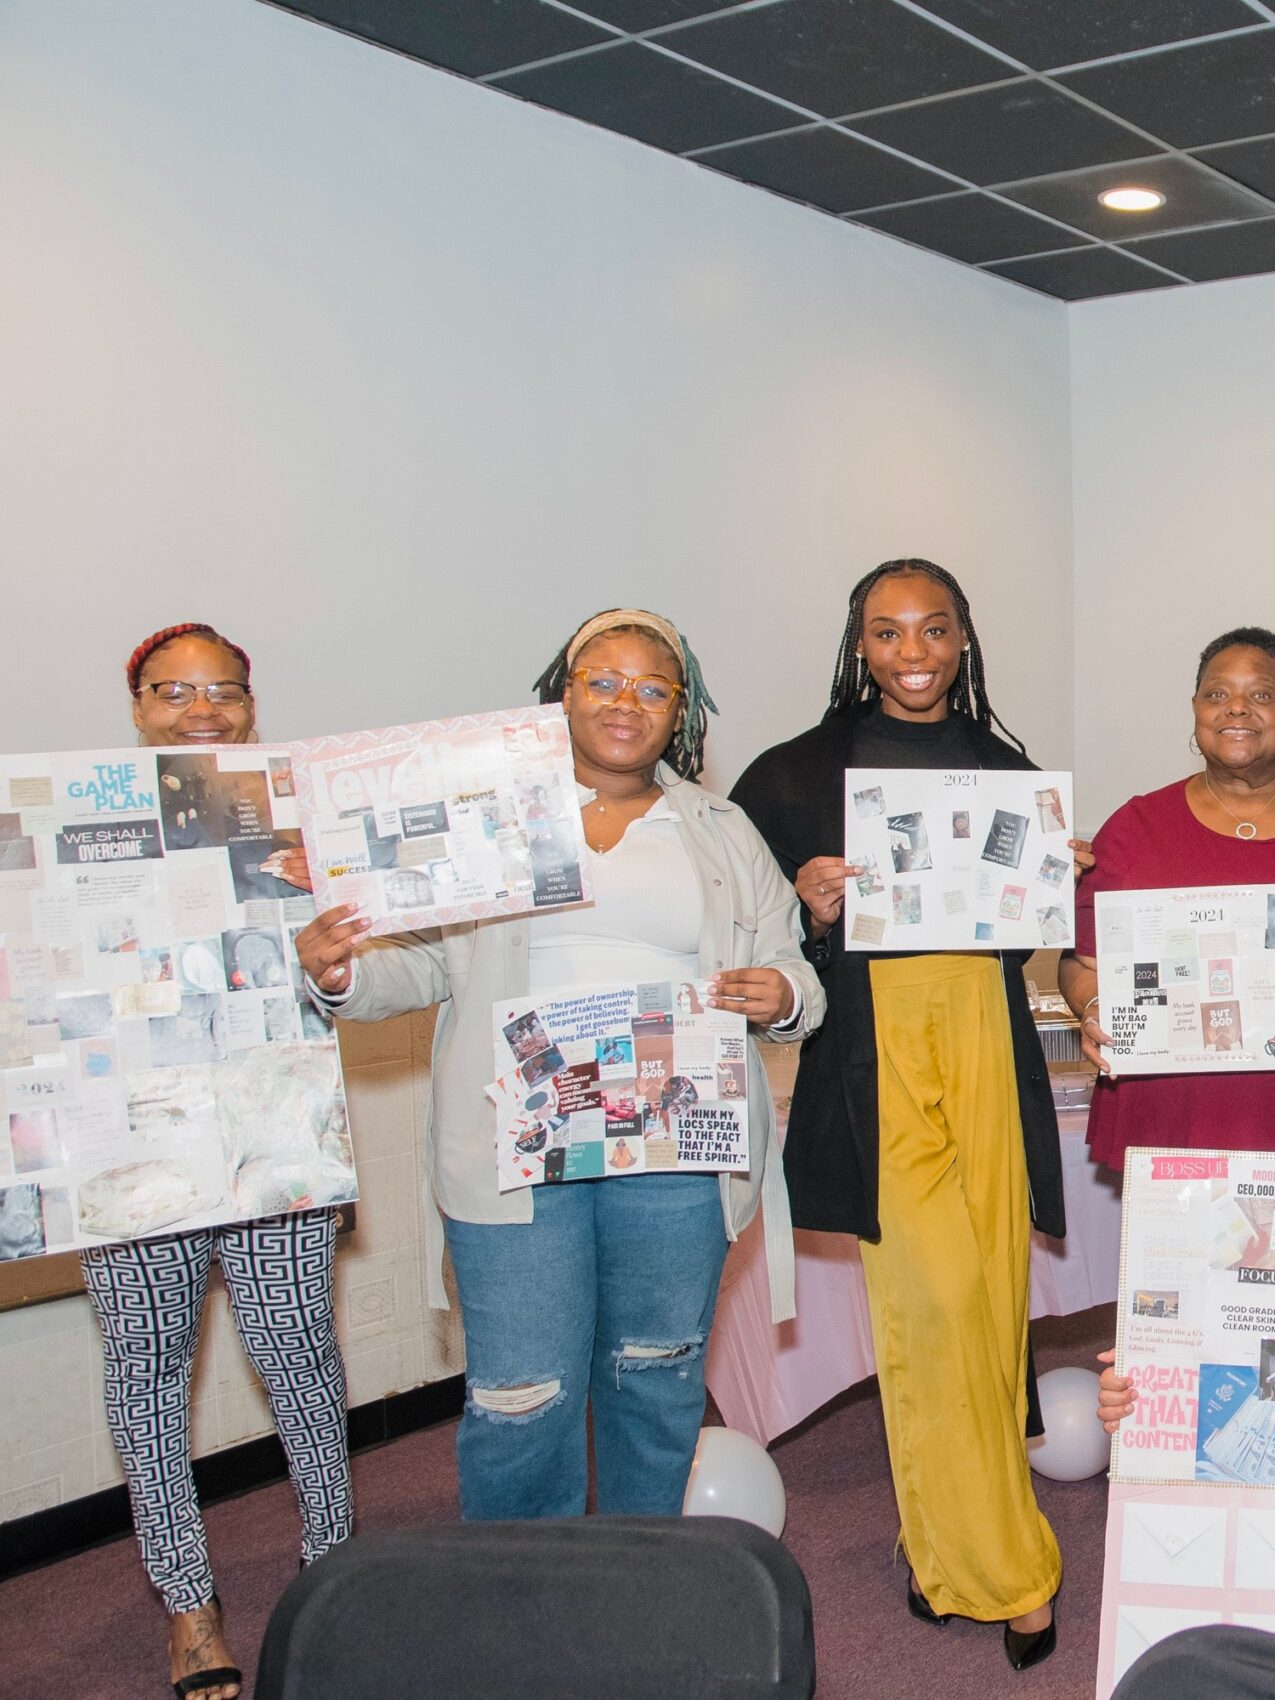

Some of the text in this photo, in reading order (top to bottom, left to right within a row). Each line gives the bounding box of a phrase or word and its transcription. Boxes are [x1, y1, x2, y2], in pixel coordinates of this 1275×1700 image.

[94, 763, 136, 780] THE
[944, 774, 977, 786] 2024
[67, 779, 133, 798] GAME
[94, 791, 154, 811] PLAN
[63, 827, 154, 844] WE SHALL
[79, 839, 143, 862] OVERCOME
[536, 891, 581, 901] COMFORTABLE
[1190, 908, 1224, 923] 2024
[1136, 970, 1157, 980] 2024
[564, 999, 586, 1008] power
[588, 994, 595, 1002] of
[546, 1011, 568, 1021] power
[578, 1003, 602, 1013] taking
[1112, 1006, 1137, 1014] I'M IN
[1210, 1008, 1230, 1018] BUT
[562, 1018, 584, 1028] power
[1128, 1014, 1148, 1022] BAG
[1210, 1018, 1232, 1028] GOD
[580, 1024, 591, 1032] get
[576, 1030, 597, 1040] about
[641, 1060, 663, 1069] BUT
[640, 1068, 666, 1078] GOD
[558, 1074, 591, 1086] character
[720, 1111, 734, 1120] MY
[678, 1120, 740, 1132] LOCS SPEAK
[679, 1130, 741, 1142] TO THE FACT
[679, 1140, 732, 1152] THAT I'M A
[678, 1151, 702, 1160] FREE
[1160, 1161, 1228, 1176] BOSS UP
[1220, 1305, 1247, 1314] GOOD
[1226, 1314, 1275, 1324] CLEAR SKIN
[1222, 1323, 1250, 1332] CLEAN
[1136, 1395, 1198, 1428] THAT
[1122, 1430, 1196, 1452] CONTEN
